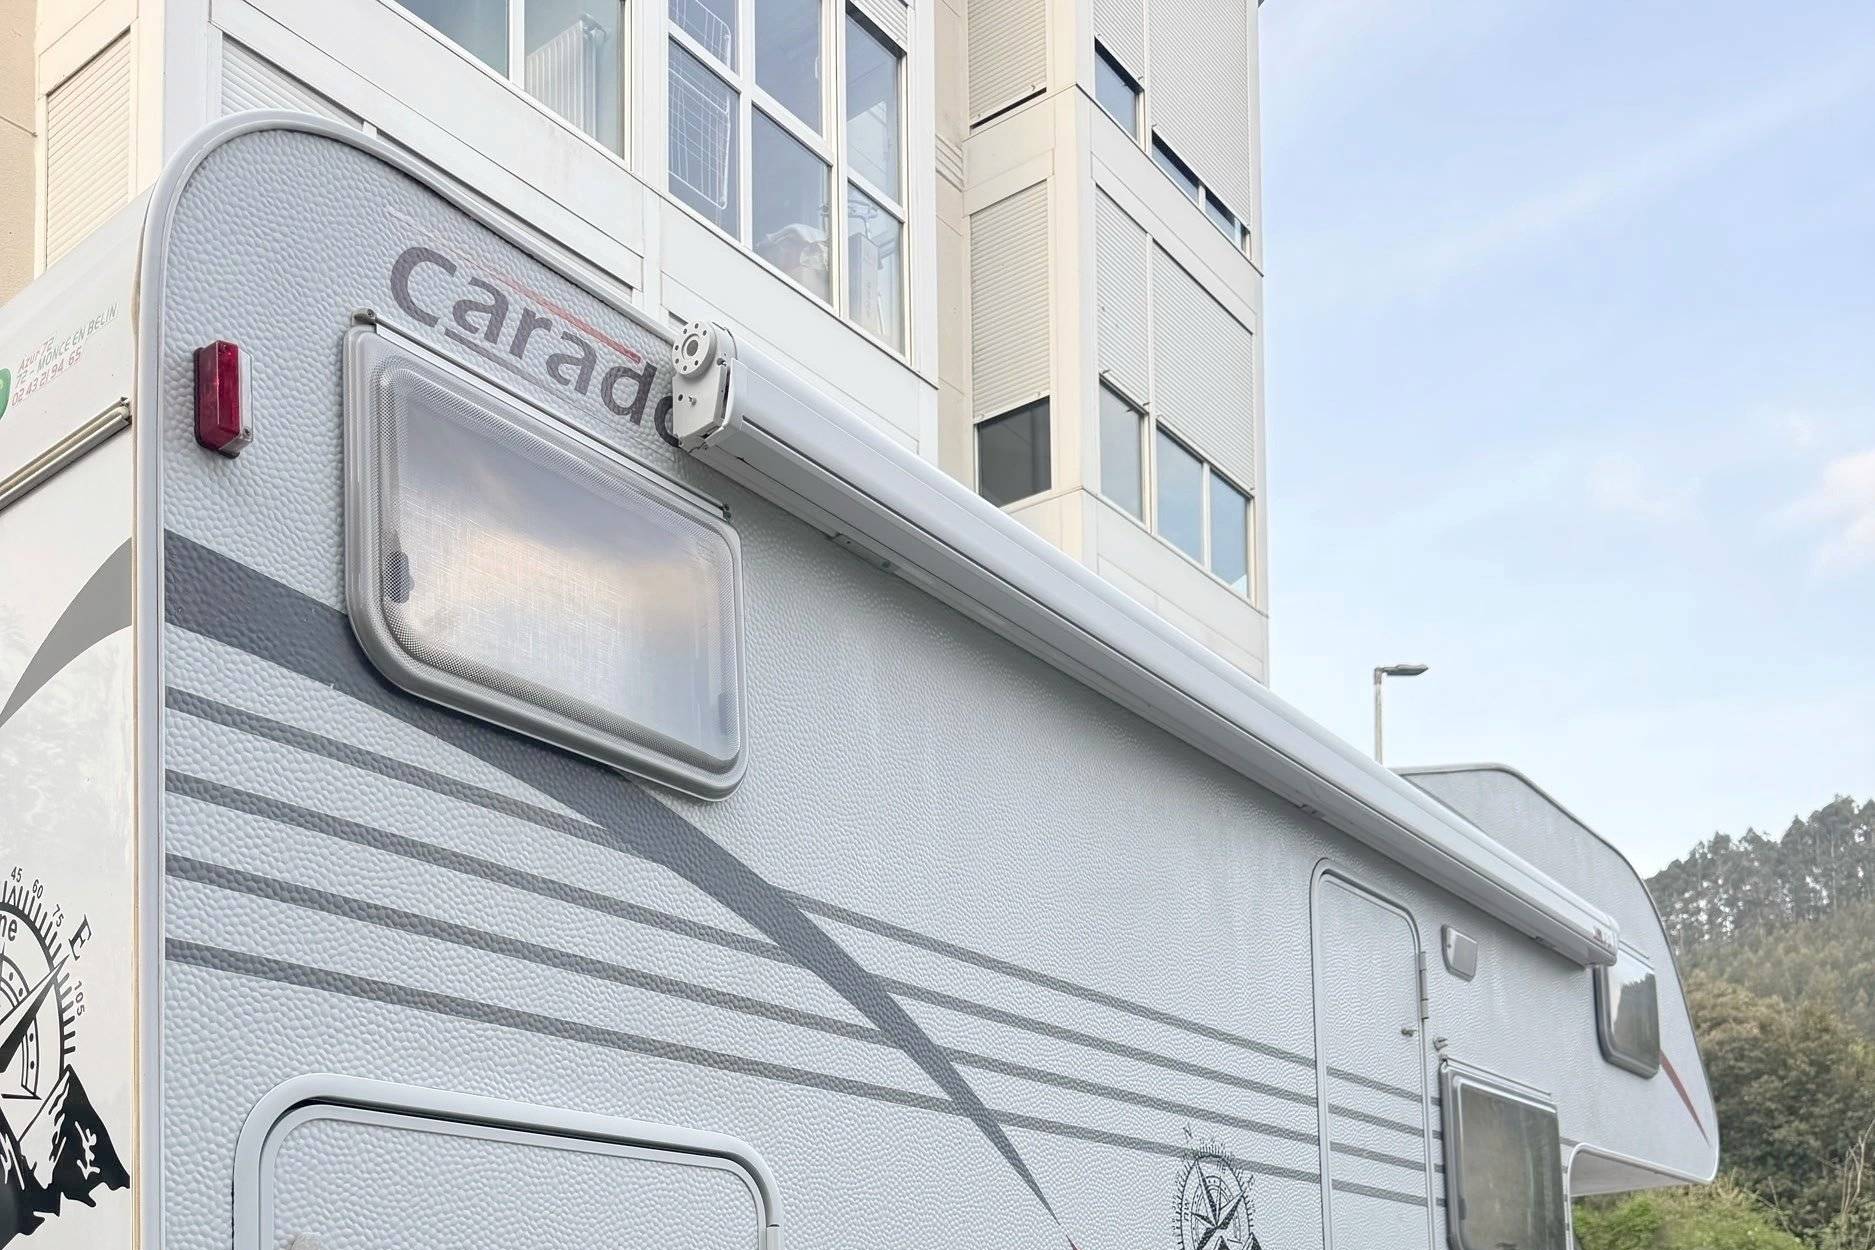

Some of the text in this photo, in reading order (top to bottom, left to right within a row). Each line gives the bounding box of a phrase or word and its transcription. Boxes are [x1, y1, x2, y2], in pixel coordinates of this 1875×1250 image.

[72, 327, 86, 346] EN
[86, 302, 118, 336] BELIN
[11, 388, 25, 407] 02
[26, 377, 38, 396] 43
[50, 359, 64, 379] 94
[10, 866, 22, 883] 45
[32, 879, 44, 899] 60
[0, 914, 18, 941] ne
[52, 903, 64, 928] 75
[68, 913, 92, 961] E
[74, 980, 85, 1016] 105
